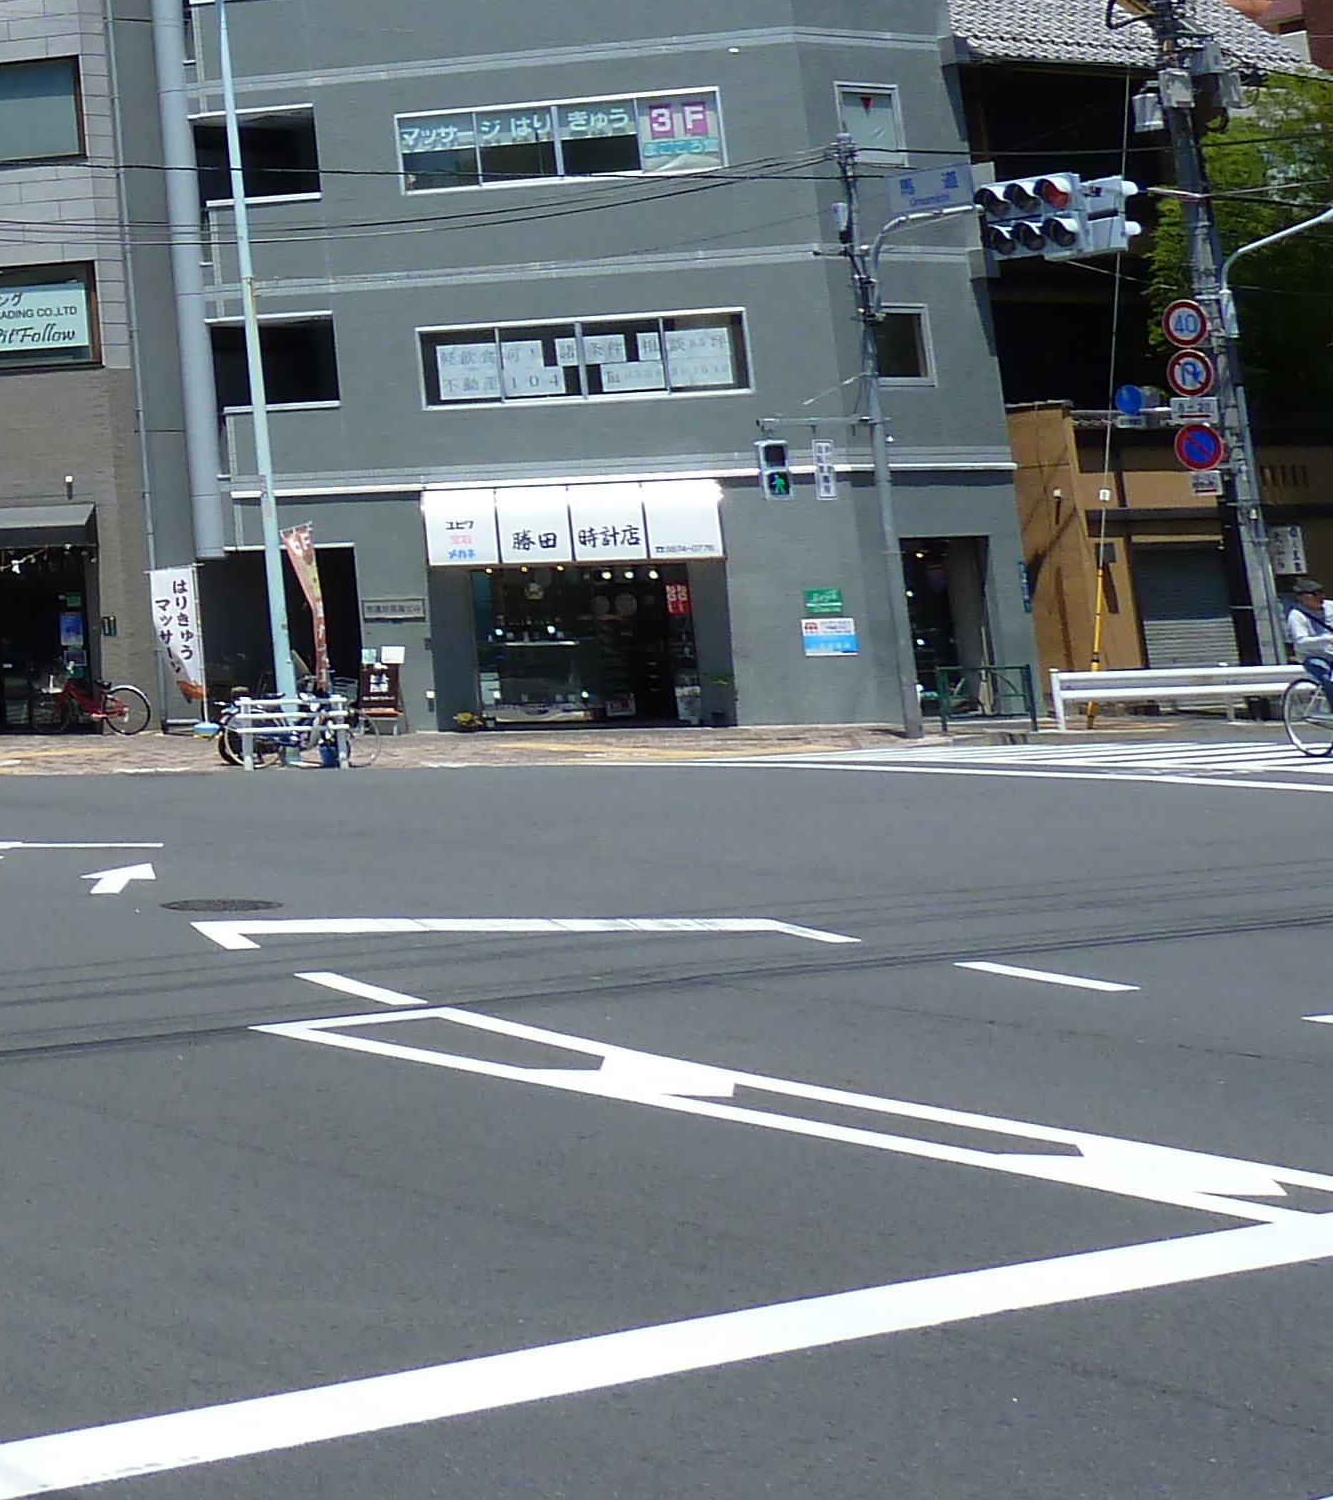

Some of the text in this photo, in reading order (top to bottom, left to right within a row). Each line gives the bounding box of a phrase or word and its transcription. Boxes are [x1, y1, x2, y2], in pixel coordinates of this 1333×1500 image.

[400, 107, 630, 144] マッサージ はり きゅう
[899, 171, 960, 197] 馬道
[1174, 313, 1199, 333] 40
[446, 520, 474, 530] ユビワ
[512, 523, 641, 551] 勝田 時計店
[448, 548, 476, 560] メガネ
[172, 579, 194, 660] はりきゅう
